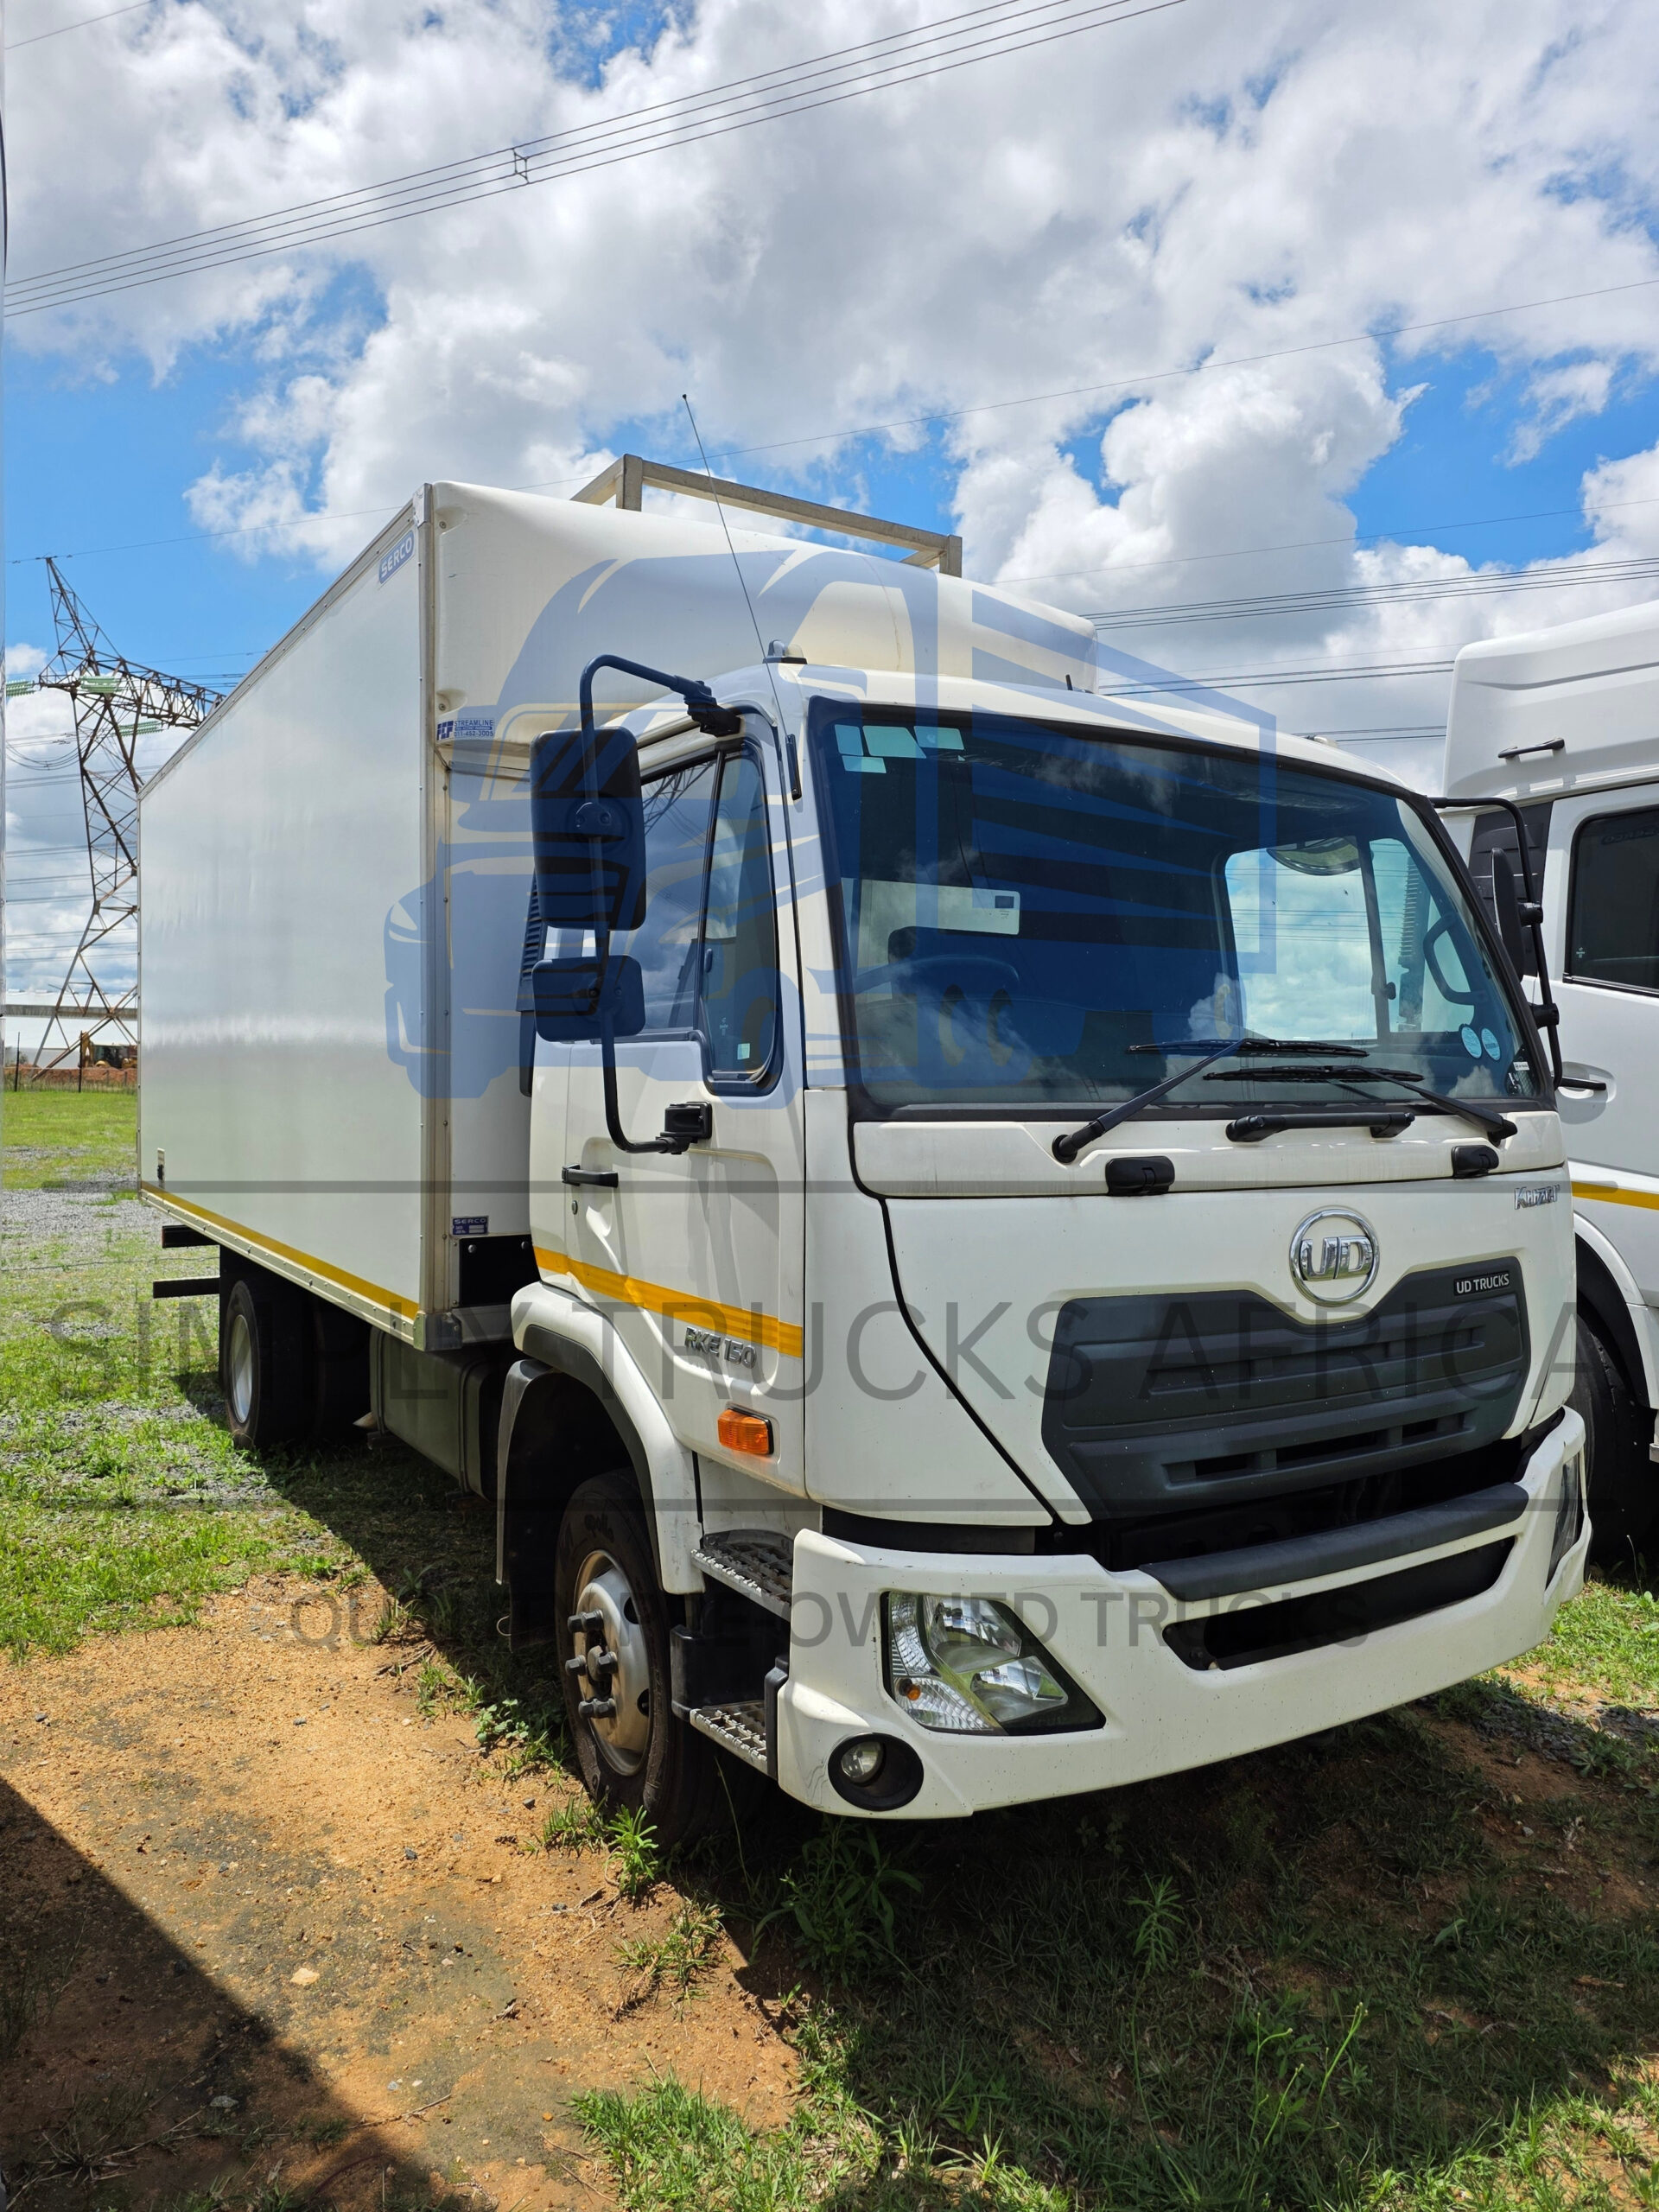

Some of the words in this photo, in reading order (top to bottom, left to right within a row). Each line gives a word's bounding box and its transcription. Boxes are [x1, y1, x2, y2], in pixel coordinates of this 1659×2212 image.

[381, 537, 413, 578] SERCO
[1299, 1236, 1374, 1281] UD
[1456, 1280, 1471, 1294] UD
[1473, 1274, 1510, 1291] TRUCKS
[684, 1325, 721, 1357] RKE
[724, 1338, 757, 1369] 150
